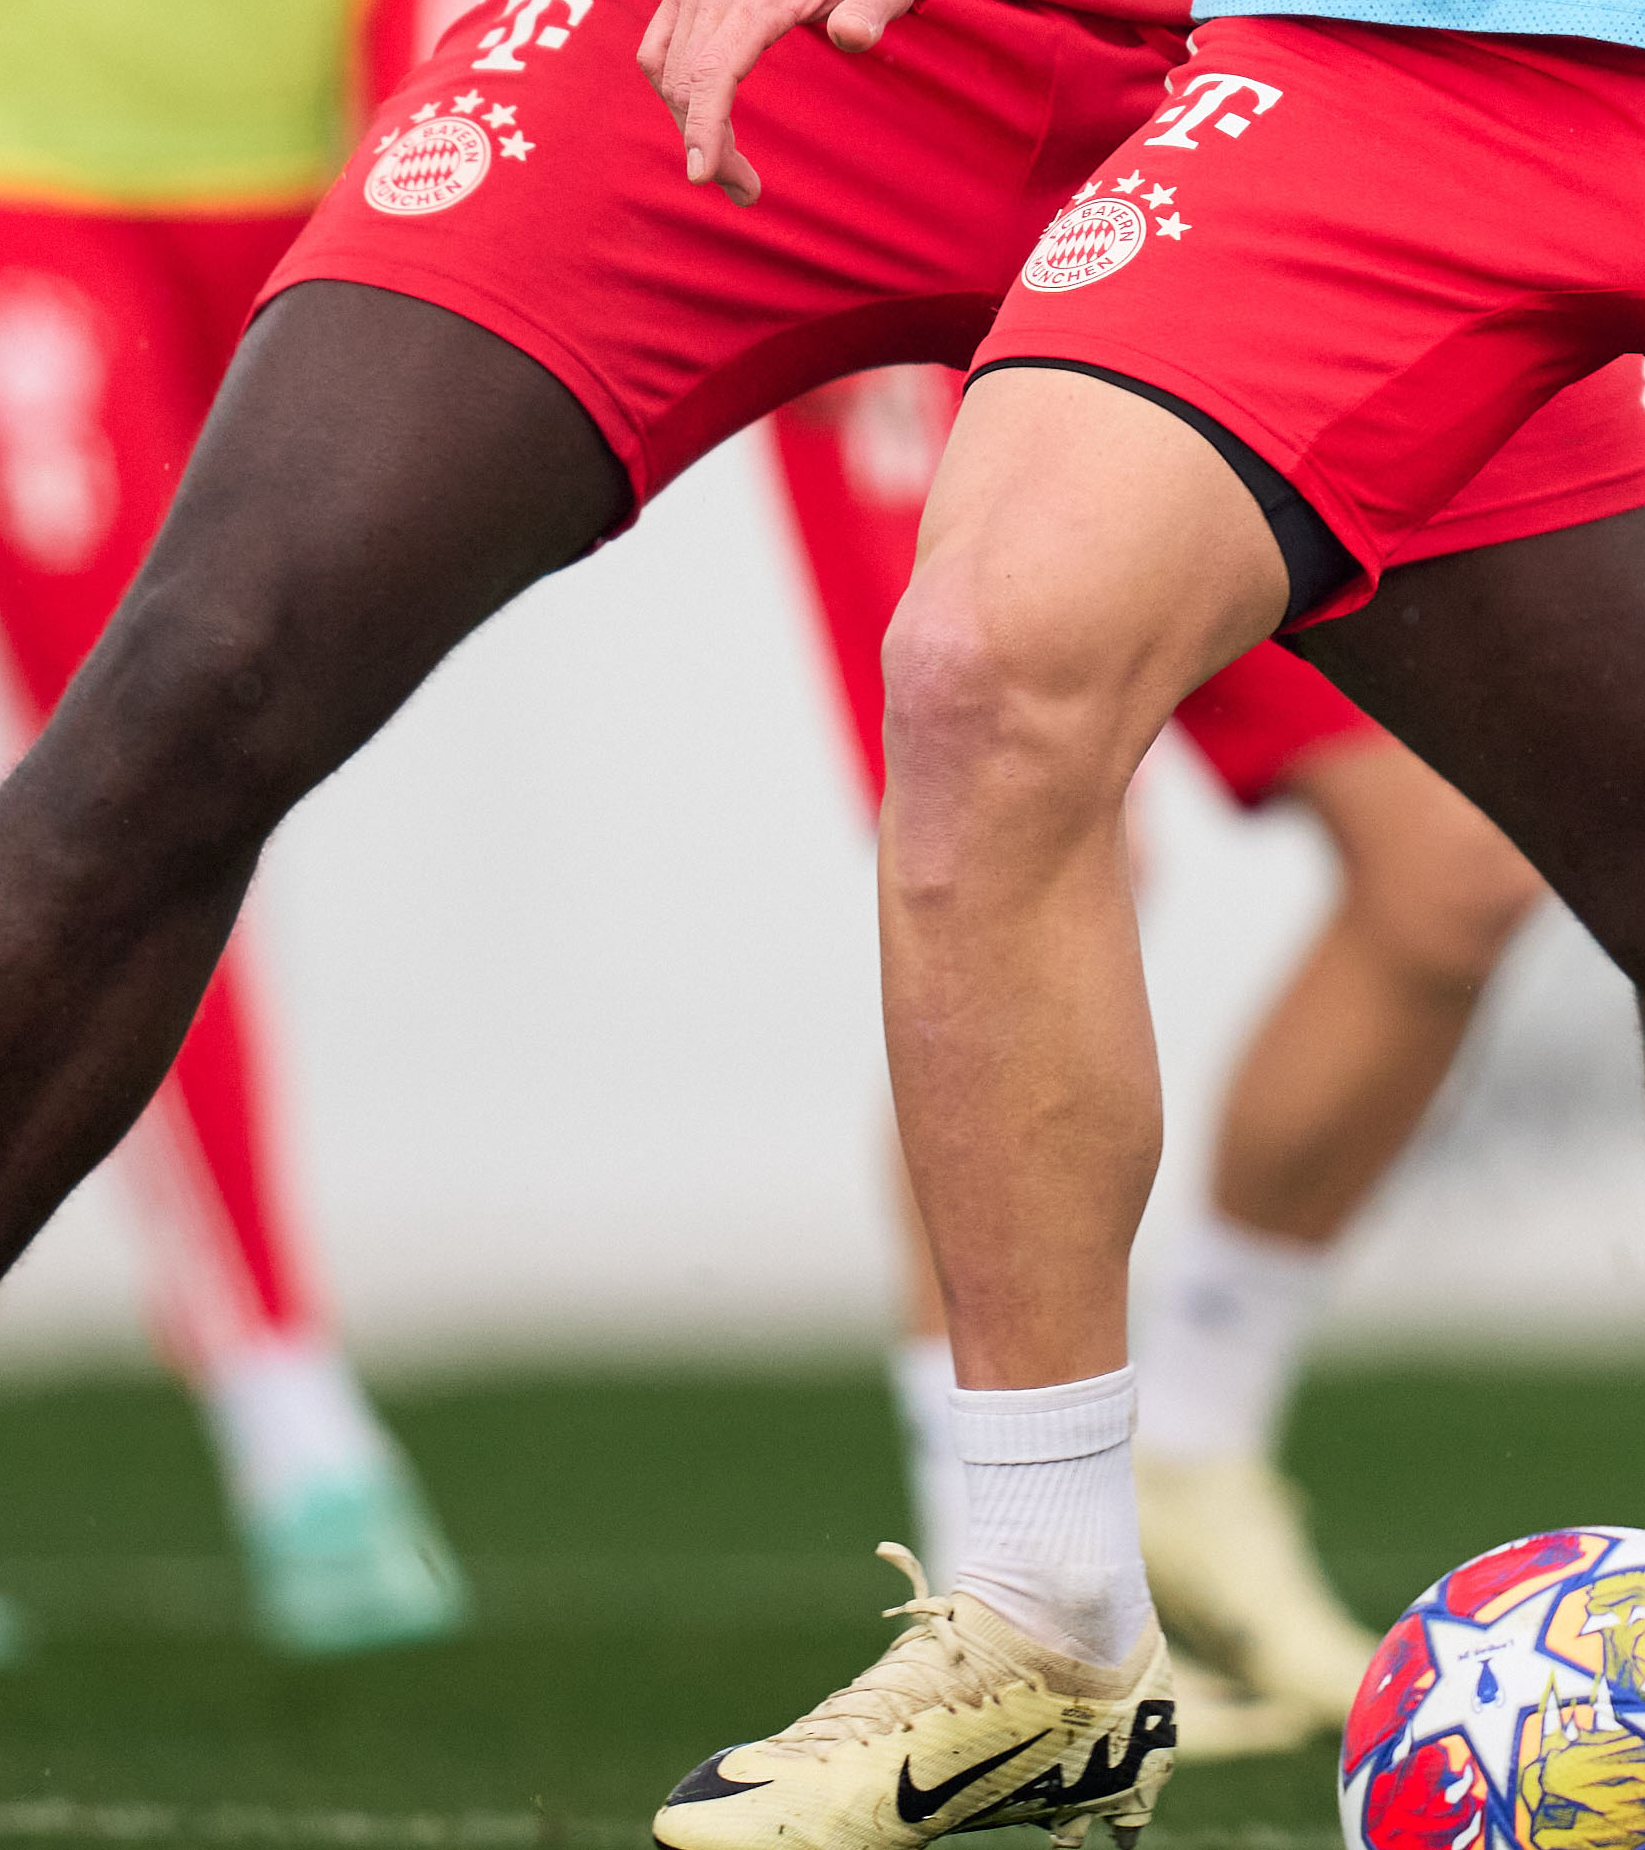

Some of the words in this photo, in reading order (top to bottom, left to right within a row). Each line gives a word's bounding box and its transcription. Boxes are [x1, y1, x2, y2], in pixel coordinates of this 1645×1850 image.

[1143, 73, 1284, 149] T
[422, 125, 480, 163] BAYERN
[1081, 205, 1134, 241] BAYERN
